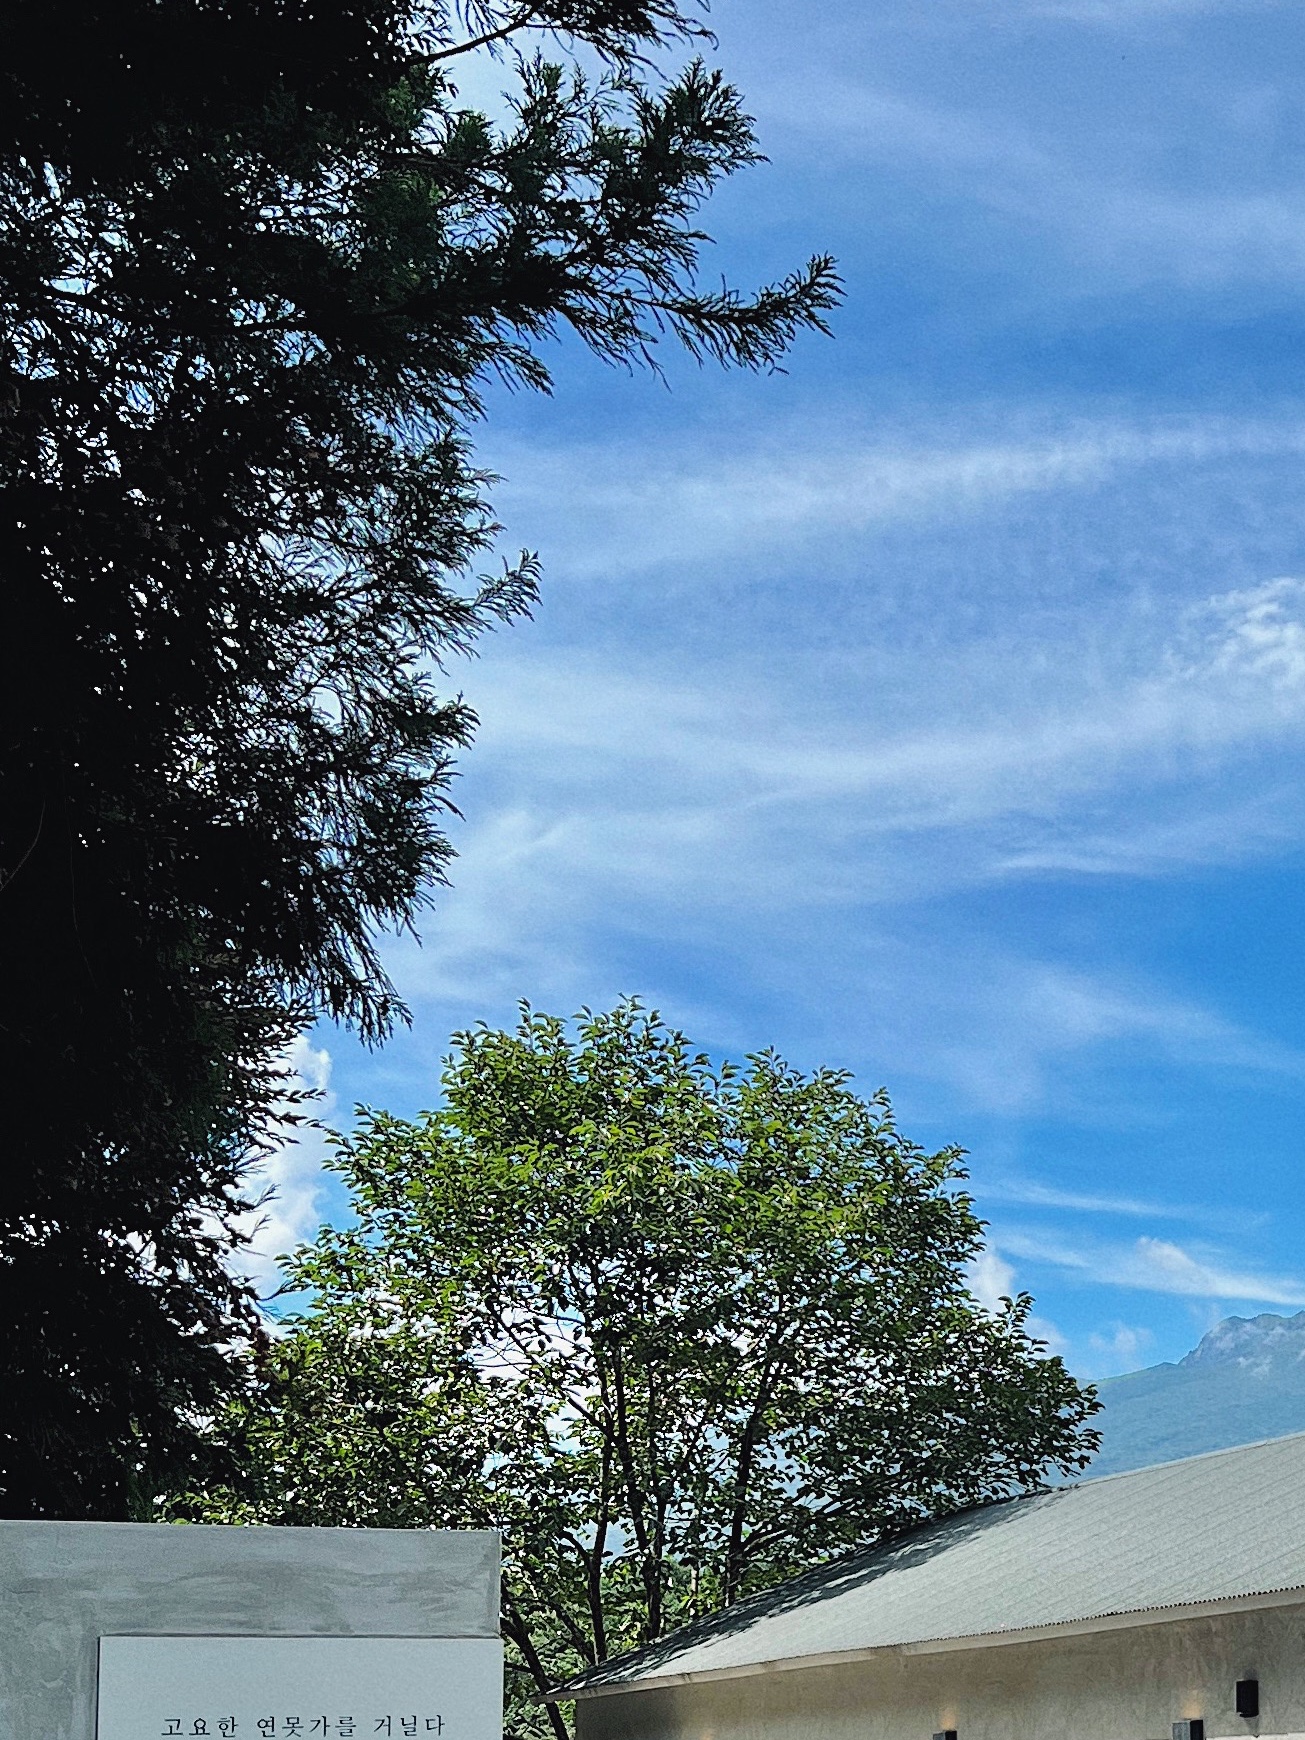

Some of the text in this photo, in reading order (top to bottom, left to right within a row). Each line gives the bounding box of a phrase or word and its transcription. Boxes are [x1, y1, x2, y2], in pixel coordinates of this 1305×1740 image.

[160, 1714, 446, 1739] 고요한 연못가를 거닐다
